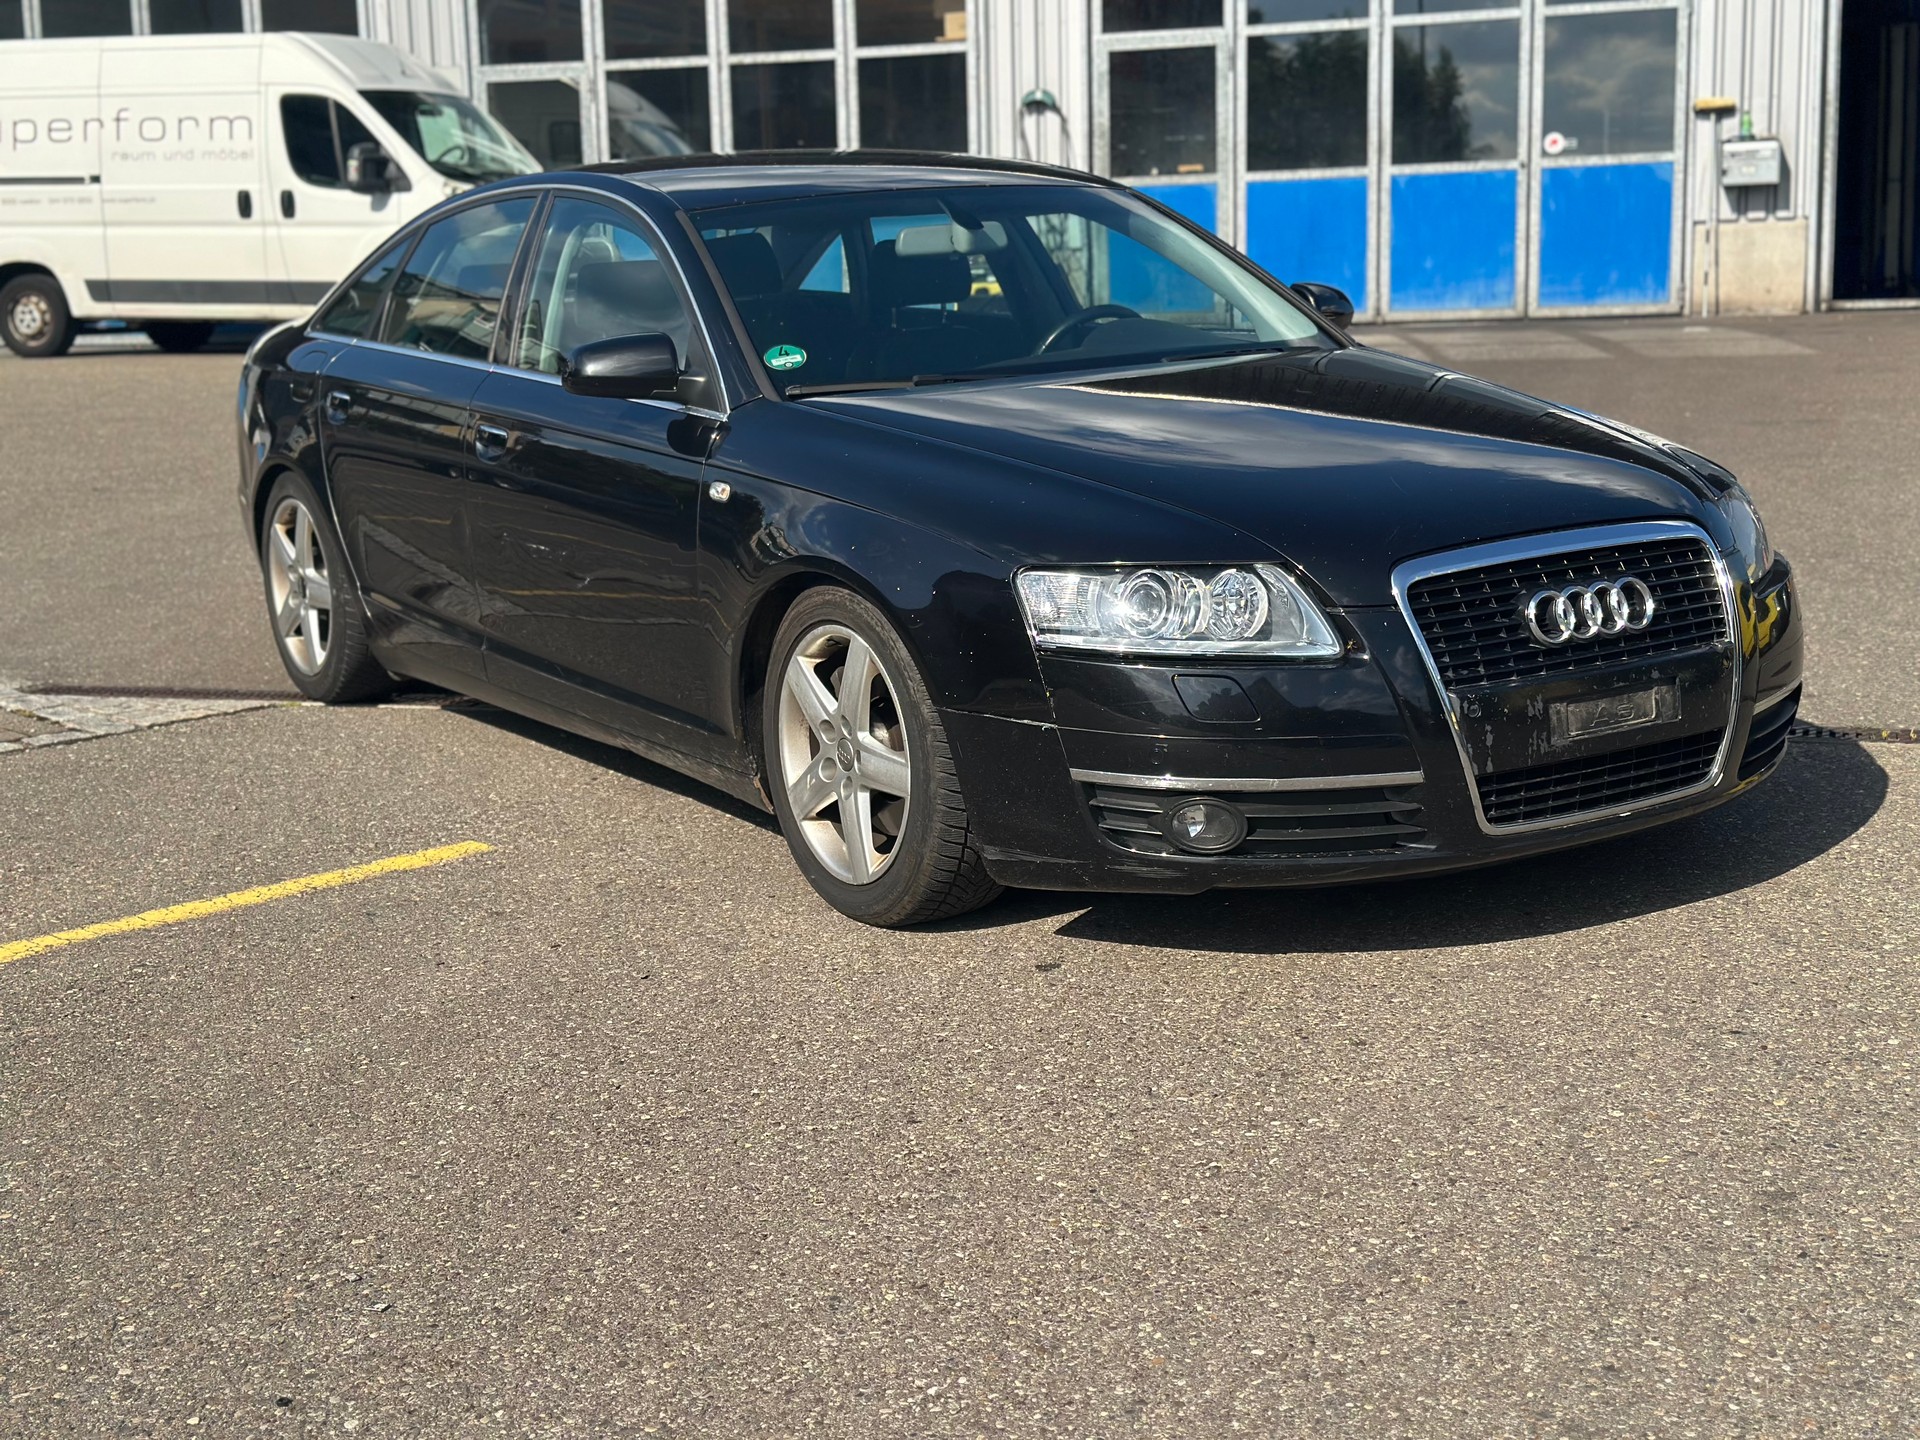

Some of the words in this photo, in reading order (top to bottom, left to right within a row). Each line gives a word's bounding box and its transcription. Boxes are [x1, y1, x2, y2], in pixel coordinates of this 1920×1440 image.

[0, 108, 253, 151] perform
[111, 150, 156, 161] raum
[163, 148, 195, 161] und
[779, 345, 789, 356] 4
